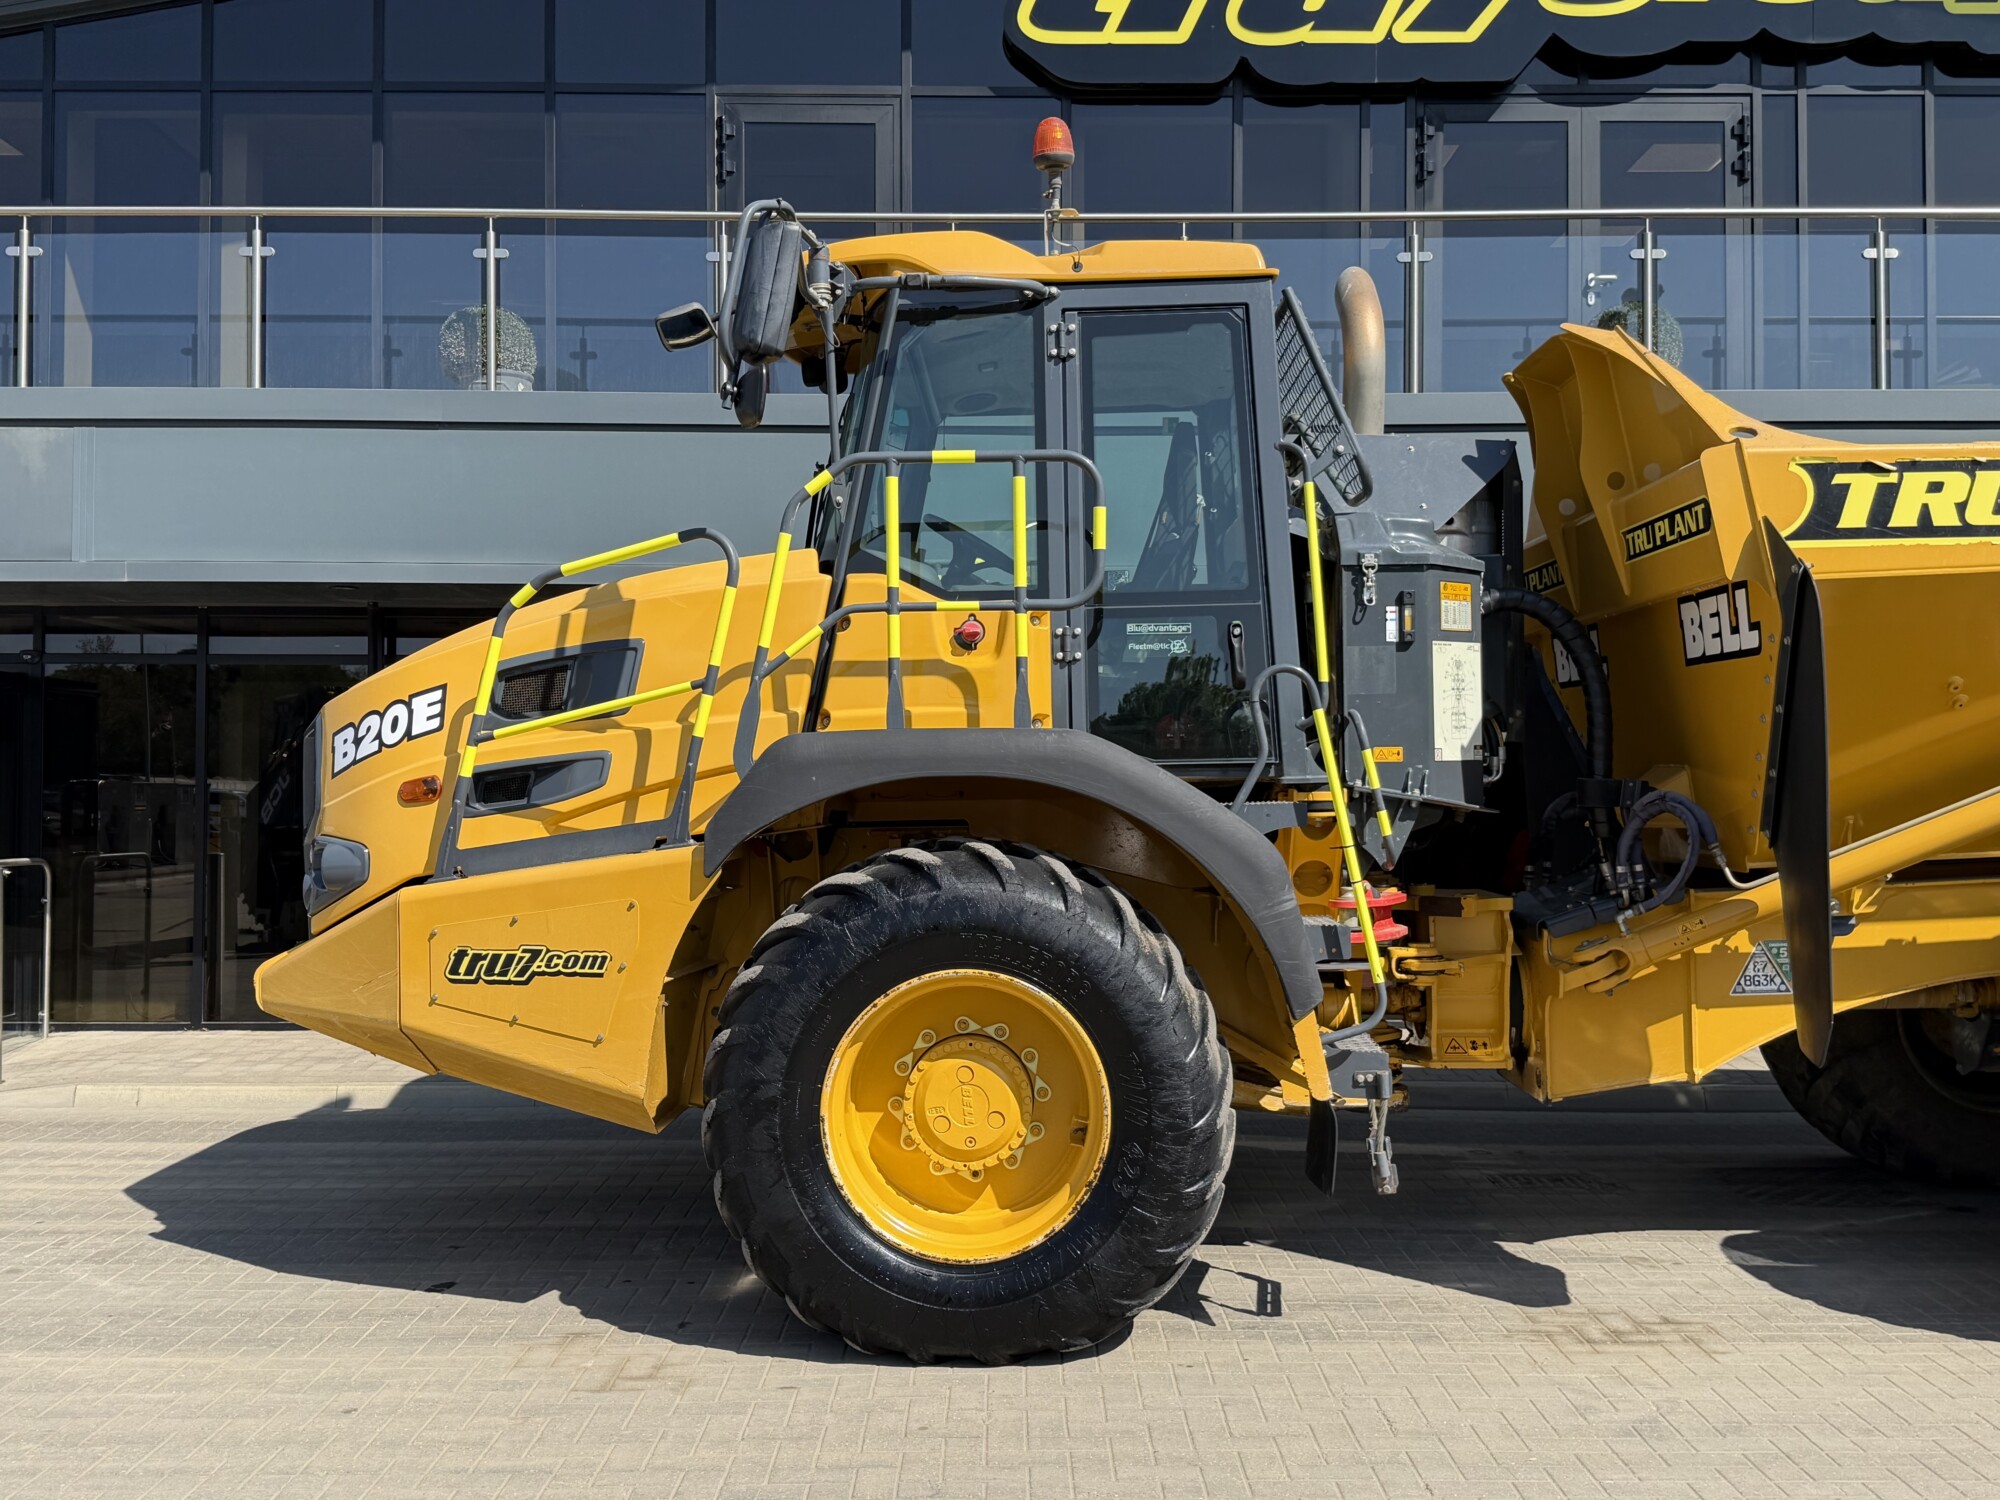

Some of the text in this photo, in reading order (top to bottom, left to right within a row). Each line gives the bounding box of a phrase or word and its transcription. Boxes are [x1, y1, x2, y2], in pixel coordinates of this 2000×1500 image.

[1625, 503, 1705, 556] TRU PLANT
[1679, 587, 1760, 660] BELL
[333, 687, 444, 775] B20E
[445, 946, 612, 983] tru7.com
[1743, 974, 1777, 987] BG3K
[960, 1086, 976, 1127] BELL
